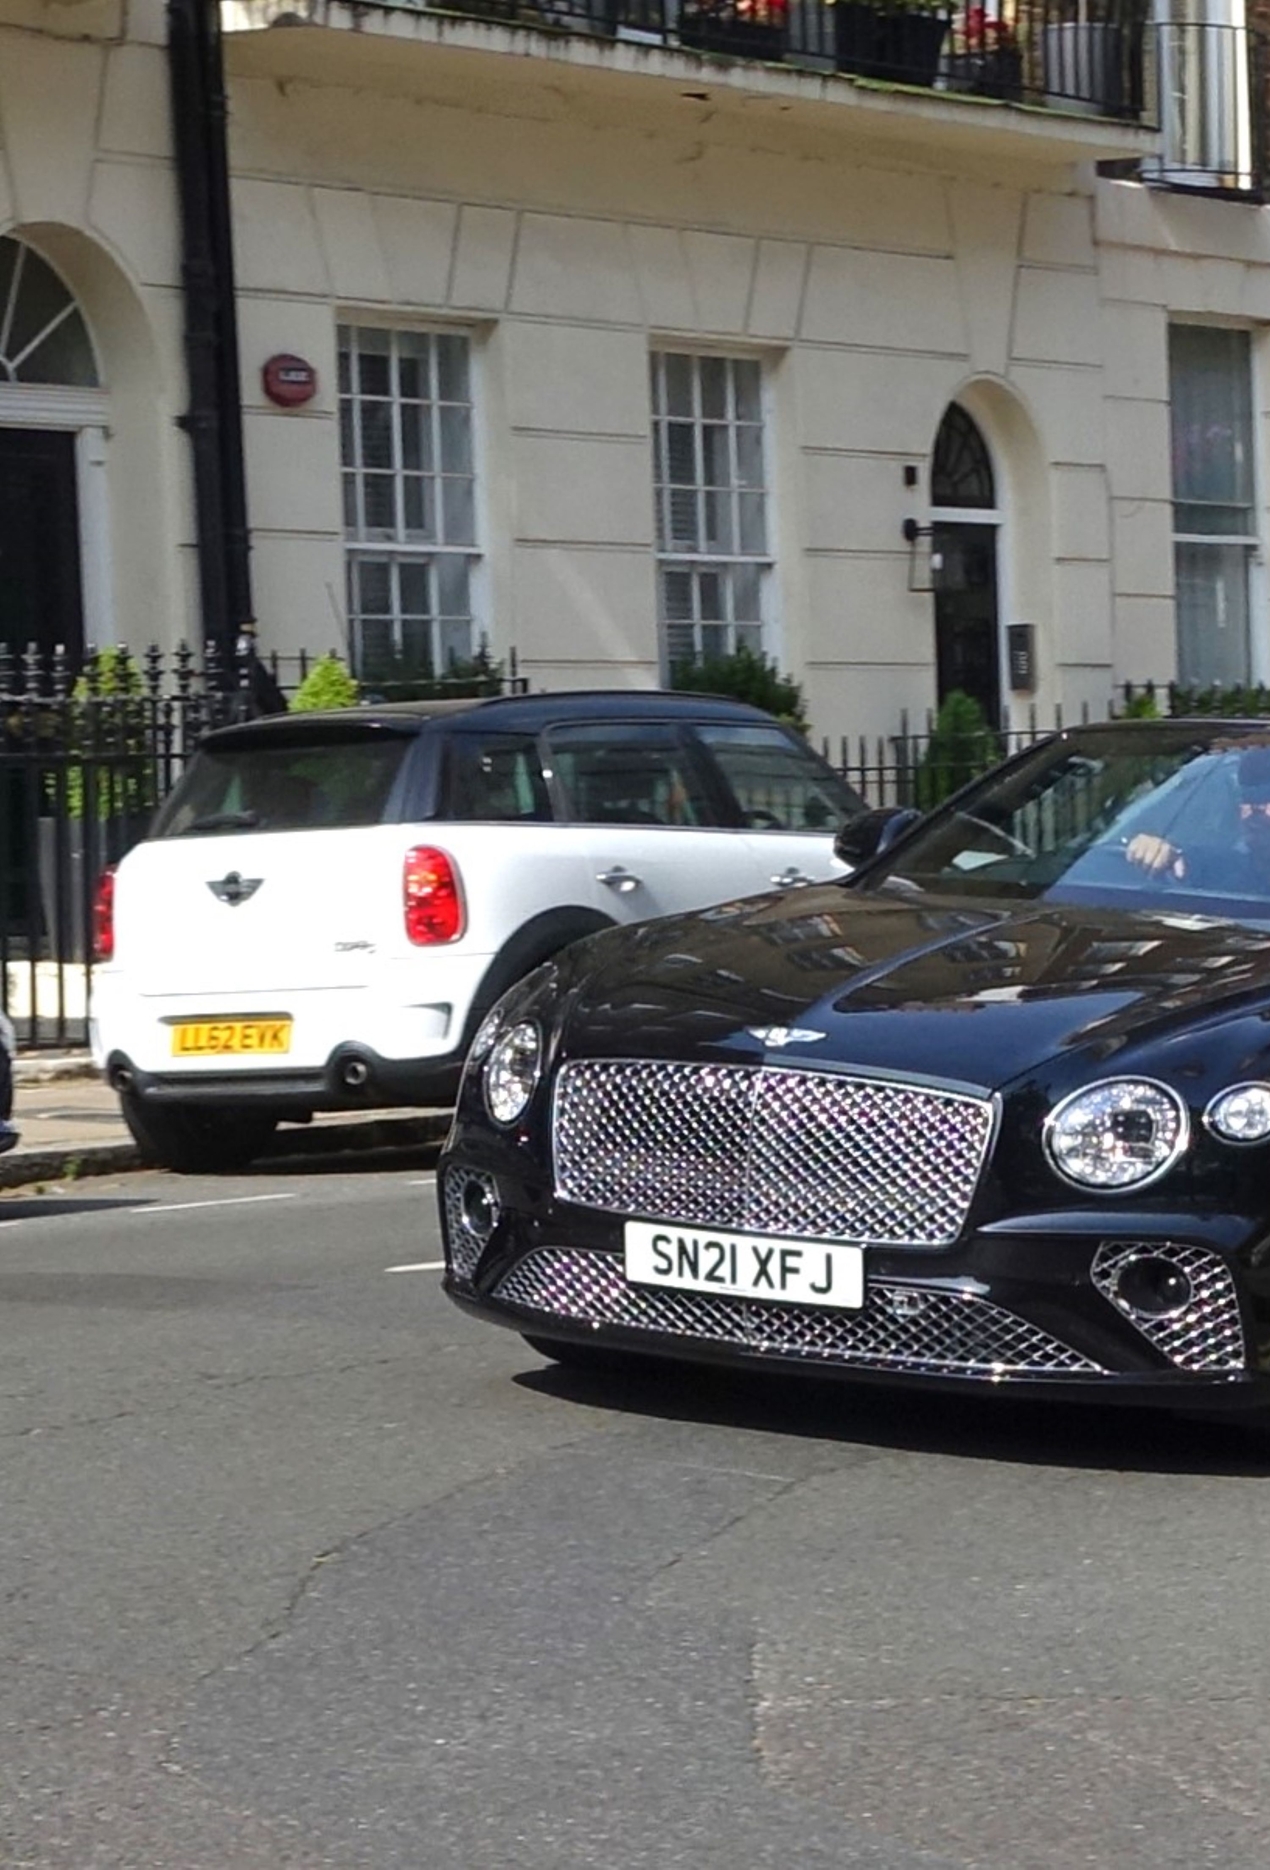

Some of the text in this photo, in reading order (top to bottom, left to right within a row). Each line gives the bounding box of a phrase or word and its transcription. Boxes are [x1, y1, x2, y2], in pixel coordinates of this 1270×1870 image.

[179, 1025, 235, 1050] LL62
[652, 1234, 832, 1294] SN21 XFJ
